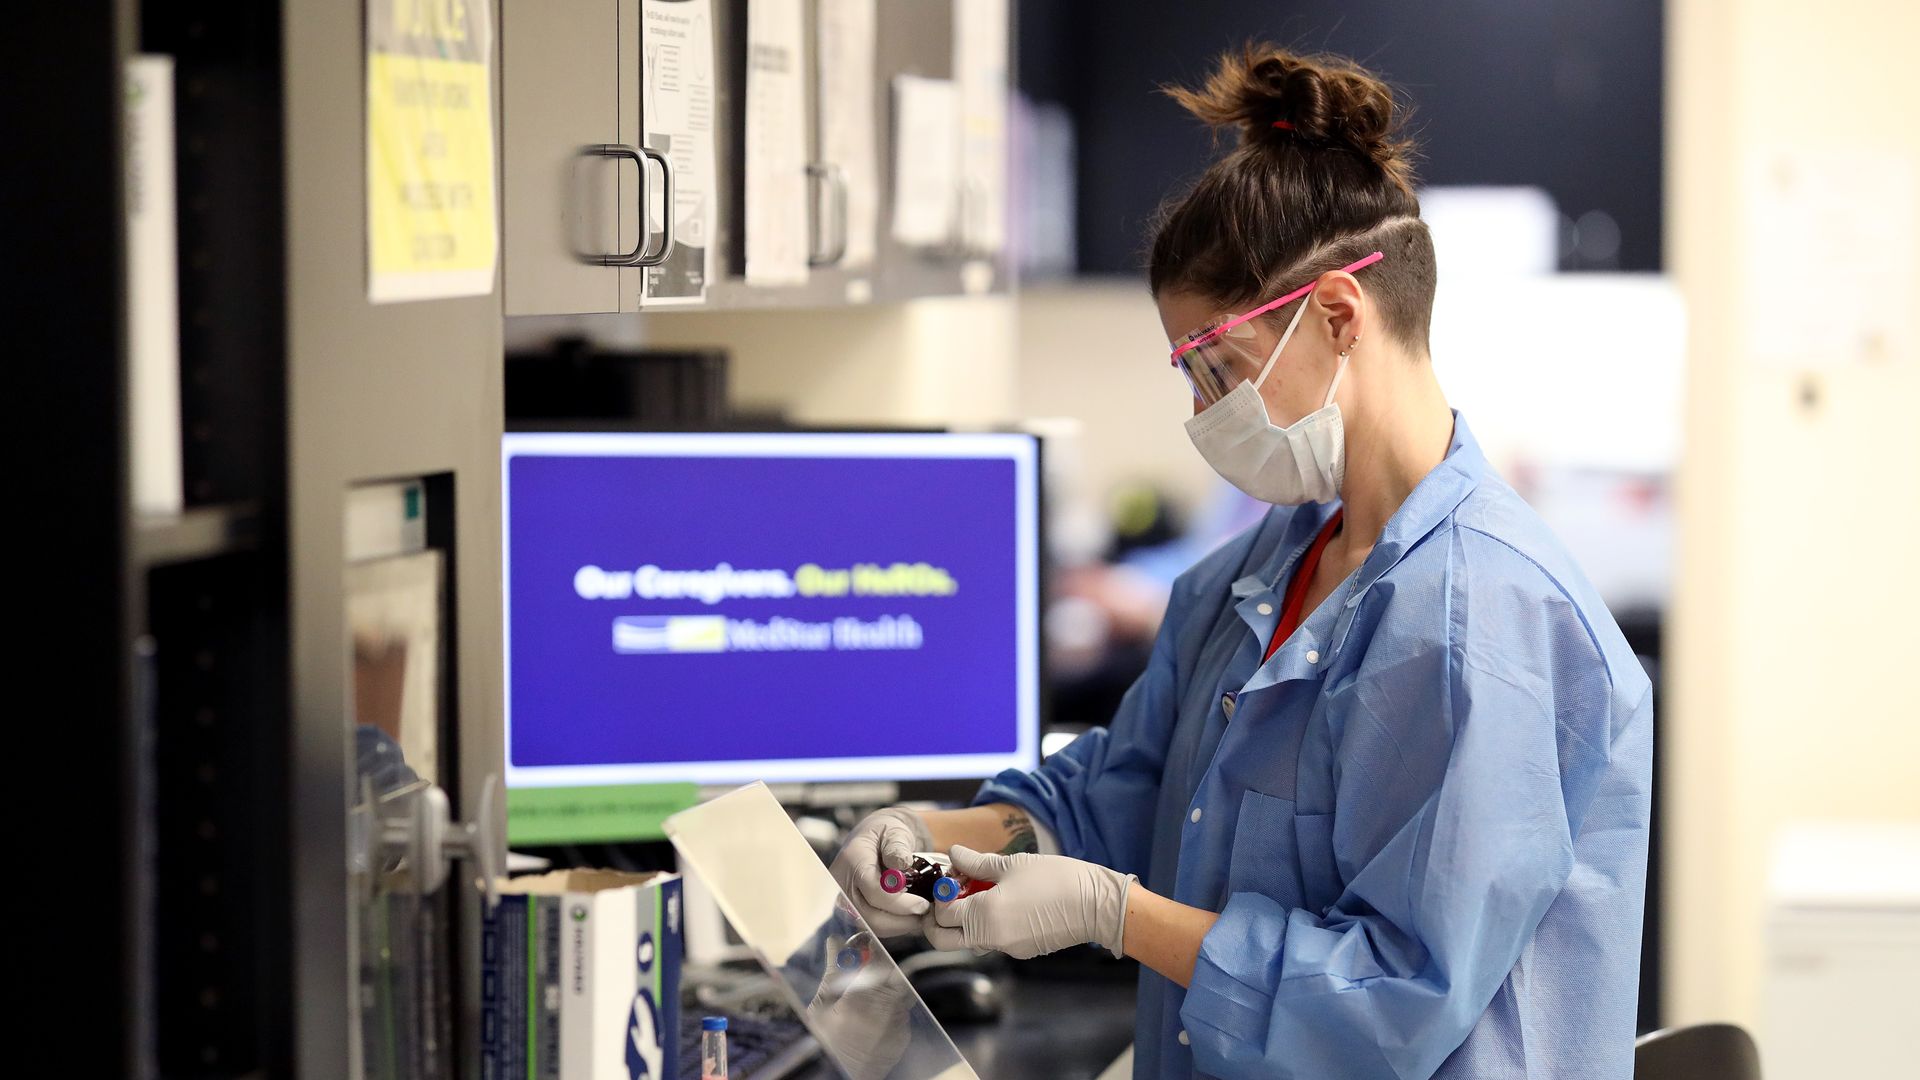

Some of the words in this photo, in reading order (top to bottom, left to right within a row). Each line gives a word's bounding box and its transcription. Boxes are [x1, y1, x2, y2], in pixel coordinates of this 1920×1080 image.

[573, 564, 633, 599] Our
[633, 562, 795, 604] Caregivers.
[795, 563, 849, 597] Our
[725, 617, 832, 650] MedStar
[834, 614, 924, 649] Health
